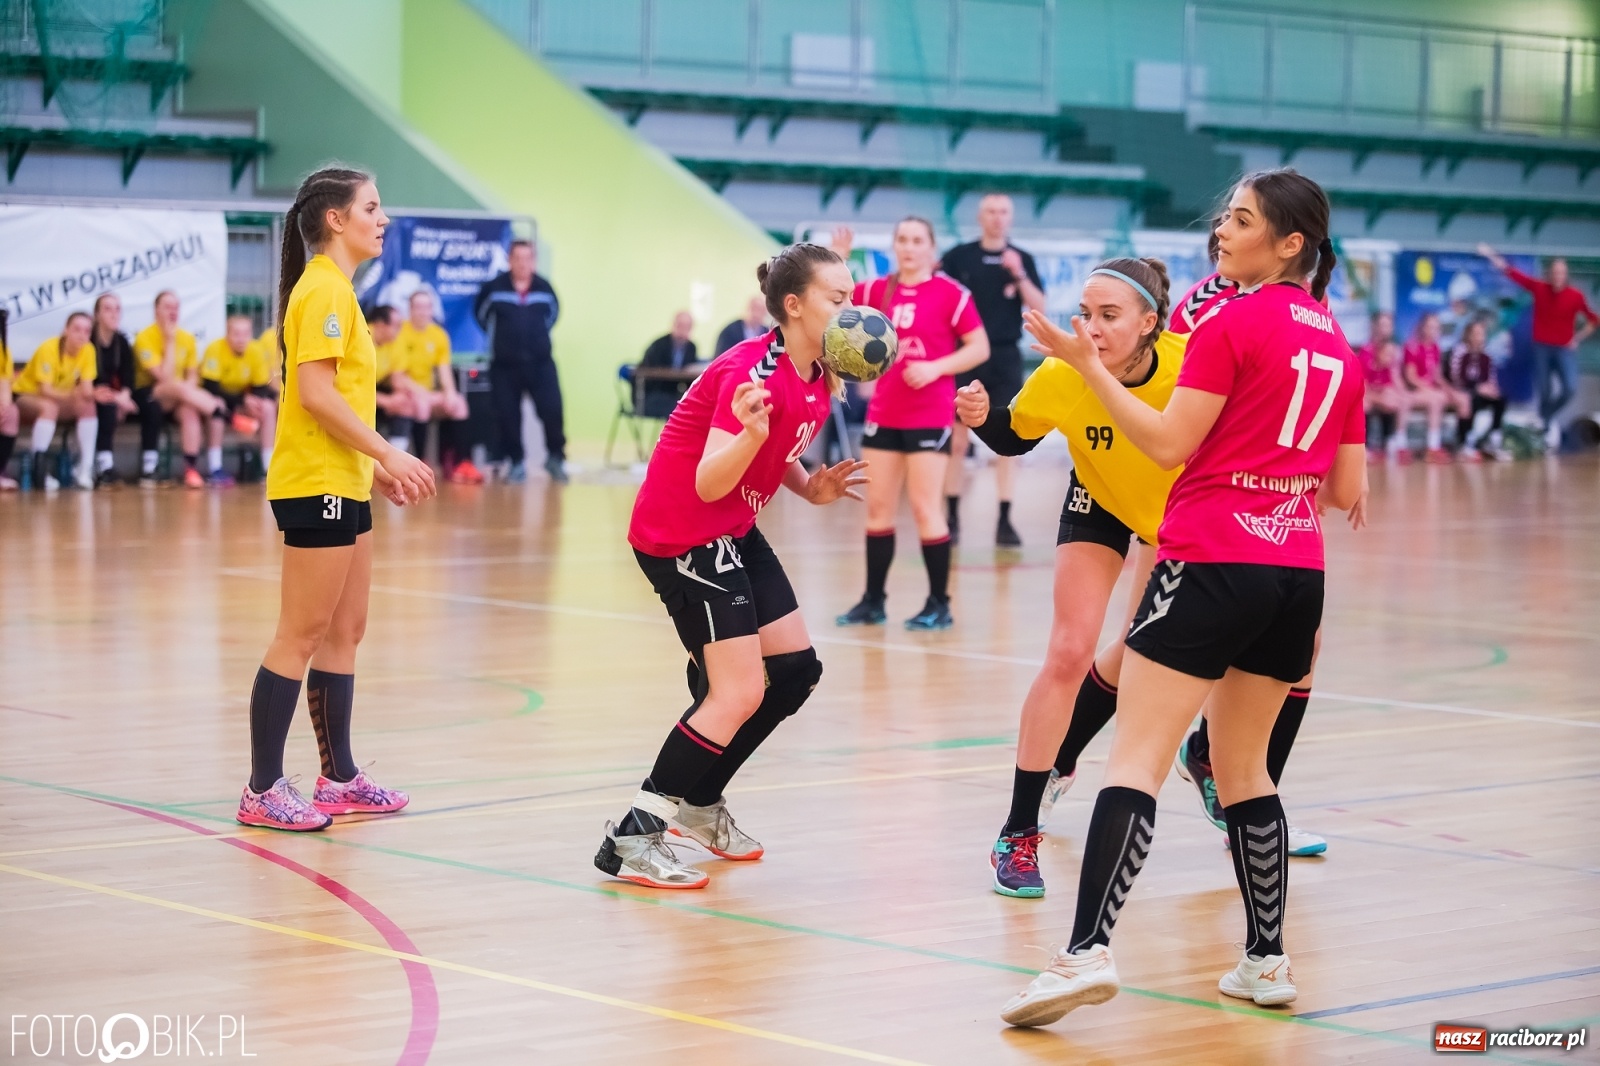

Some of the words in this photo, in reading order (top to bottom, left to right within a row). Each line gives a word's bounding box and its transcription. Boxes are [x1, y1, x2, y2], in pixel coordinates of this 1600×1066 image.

[30, 283, 54, 310] W
[62, 234, 205, 297] PORZĄDKU!
[892, 303, 917, 329] 15
[1289, 303, 1335, 335] CHROBAK
[1277, 348, 1344, 452] 17
[1085, 426, 1114, 450] 99
[322, 494, 342, 520] 31
[1068, 486, 1092, 514] 99
[1241, 512, 1314, 528] TechControl
